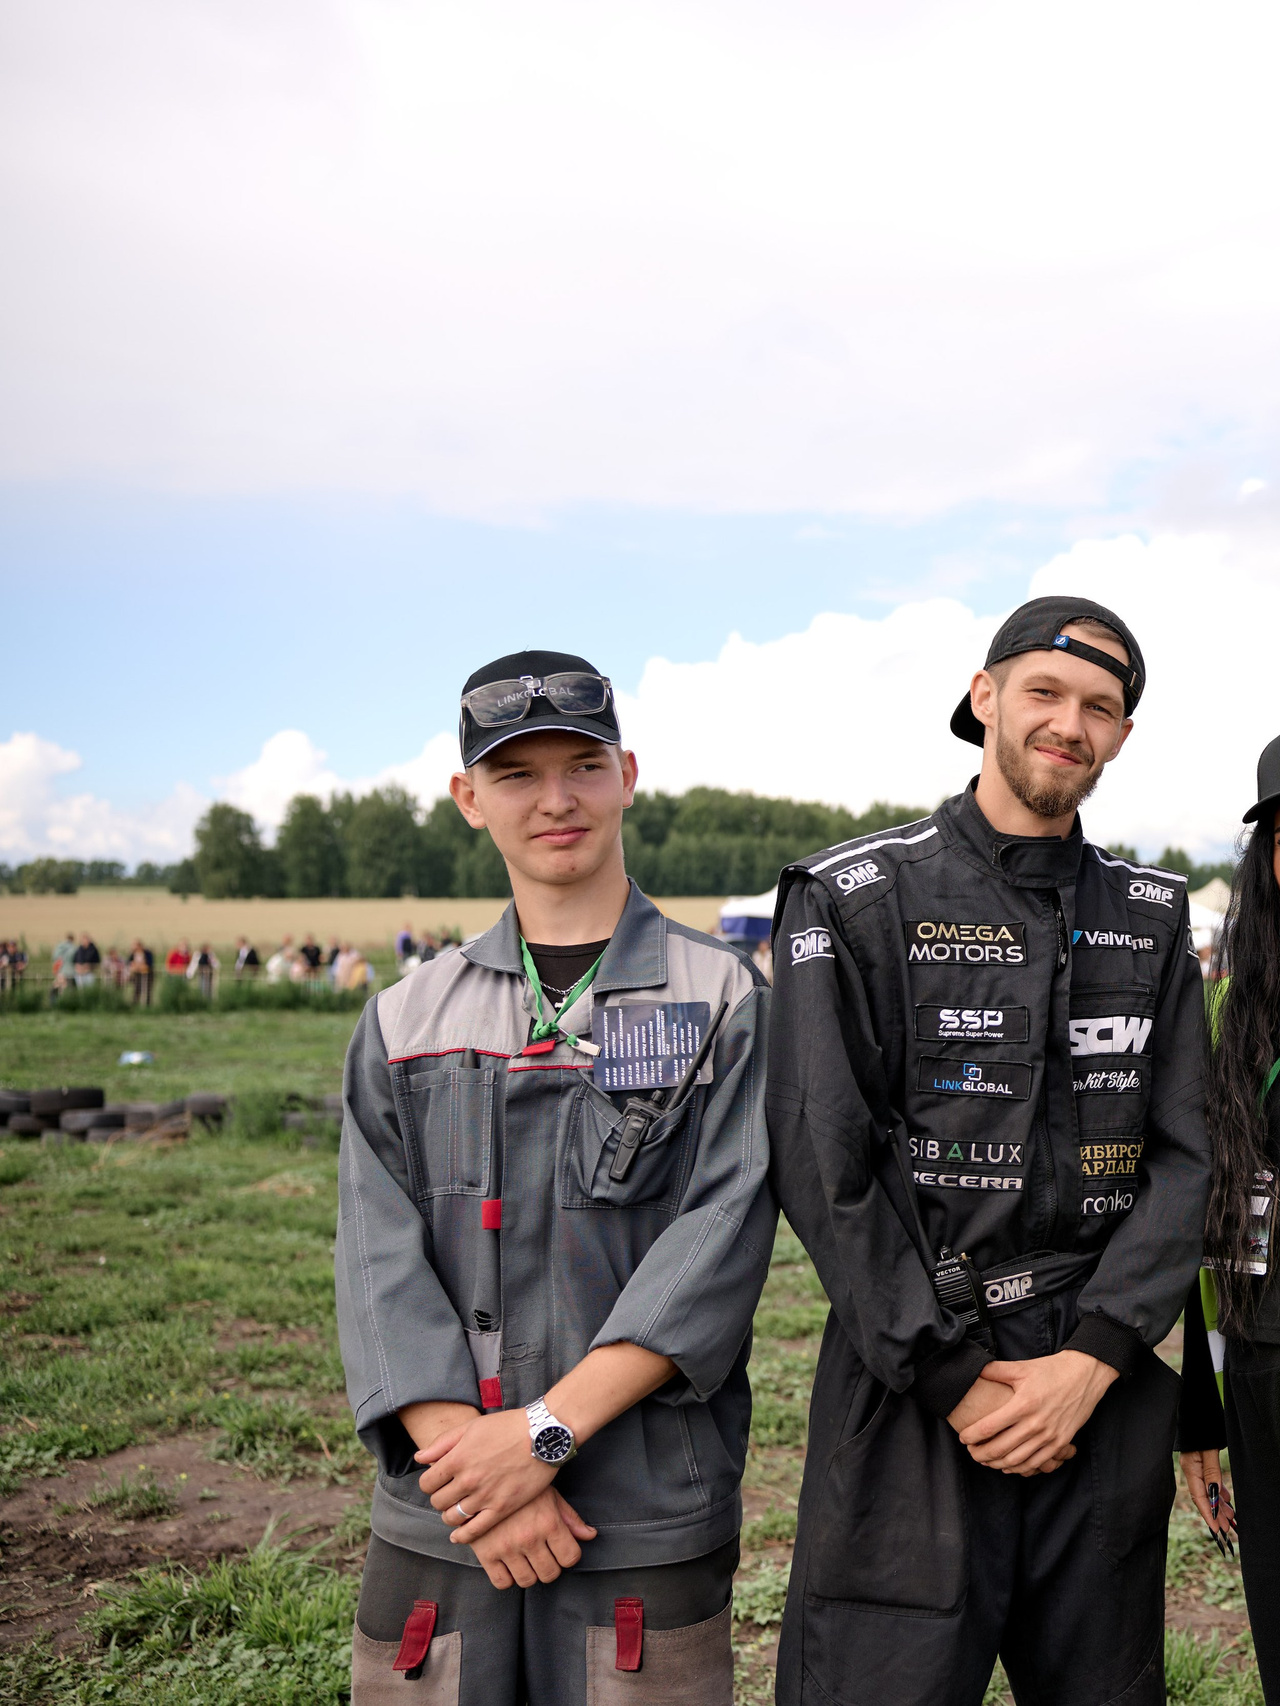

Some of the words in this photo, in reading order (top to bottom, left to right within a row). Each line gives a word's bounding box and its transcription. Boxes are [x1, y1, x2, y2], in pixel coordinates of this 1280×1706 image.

[836, 862, 879, 890] OMP
[1128, 884, 1174, 902] OMP
[917, 922, 1014, 942] OMEGA
[791, 932, 832, 959] OMP
[908, 943, 1024, 963] MOTORS
[939, 1009, 1003, 1029] SSP
[934, 1078, 1012, 1095] LINKGLOBAL
[1107, 1070, 1140, 1092] Style
[1082, 1159, 1137, 1177] АРДАН
[1081, 1189, 1133, 1214] ronko
[936, 1266, 961, 1277] VECTOR
[985, 1275, 1033, 1303] OMP
